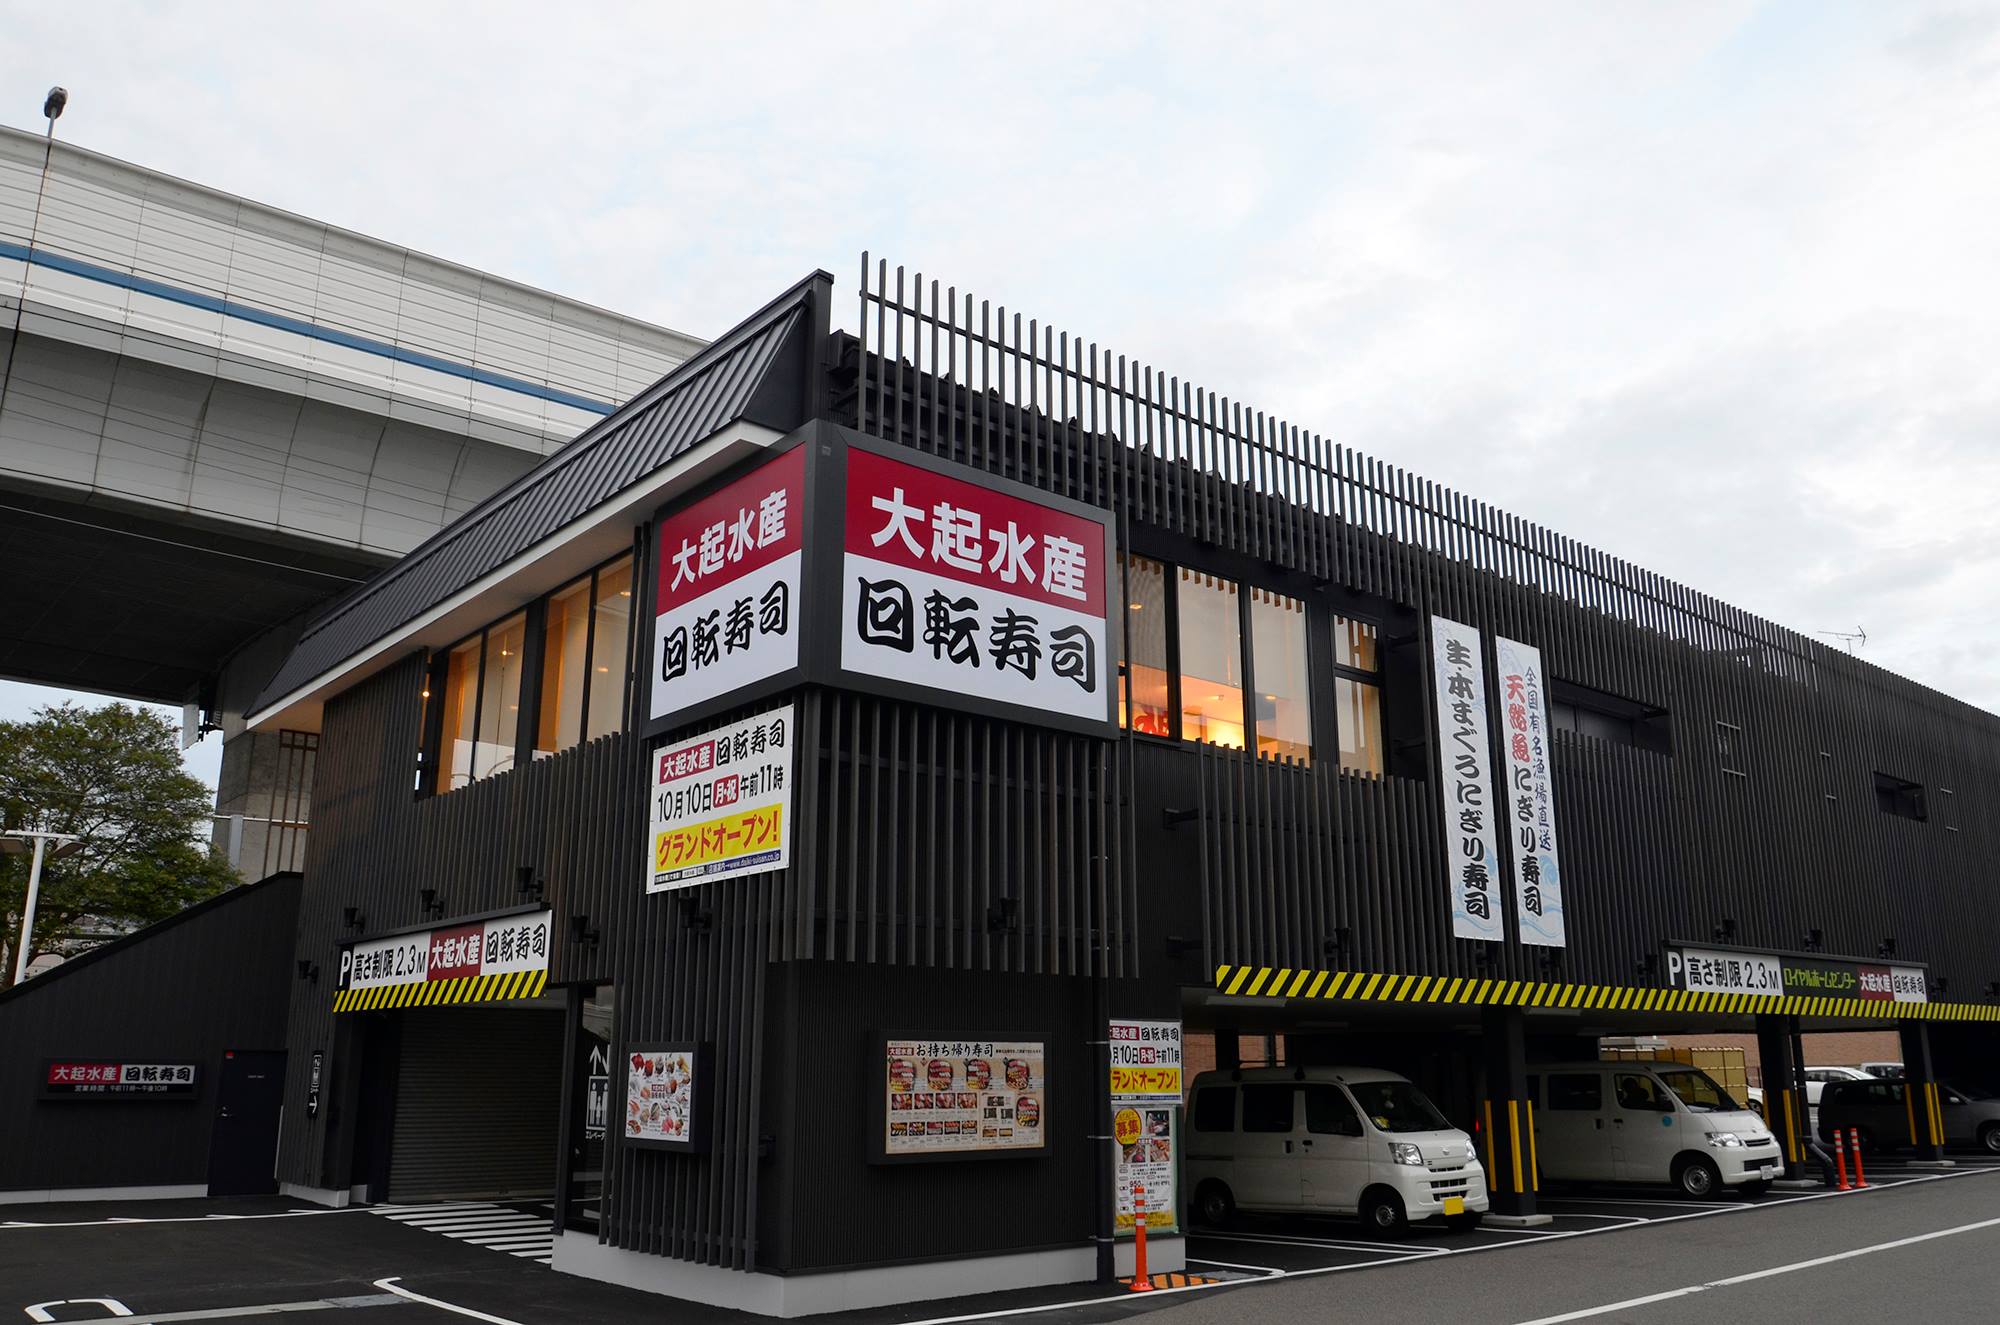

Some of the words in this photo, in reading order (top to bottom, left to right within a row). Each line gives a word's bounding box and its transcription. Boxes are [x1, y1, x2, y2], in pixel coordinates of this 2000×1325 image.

[671, 488, 787, 592] 大起水産
[871, 487, 1087, 601] 大起水産
[662, 580, 788, 682] 回転寿司
[858, 577, 1095, 693] 回転寿司
[664, 745, 711, 780] 大起水産
[716, 719, 785, 766] 回転寿司
[1525, 666, 1552, 851] 全国有名漁場直送
[658, 783, 712, 822] 10月10日
[740, 764, 783, 799] 午前11時
[1505, 675, 1542, 916] 天然魚にぎり寿司
[659, 811, 778, 866] グランドオープン!
[339, 951, 351, 986] P
[430, 934, 481, 970] 大起水産
[485, 922, 546, 964] 回転寿司
[1667, 951, 1682, 986] P
[1784, 967, 1856, 989] ロイヤルホームセンター
[1860, 972, 1892, 992] 大起水産
[916, 1043, 993, 1058] お持ち帰り寿司
[1110, 1027, 1137, 1039] 起水産
[1142, 1027, 1179, 1041] 回転寿司
[54, 1066, 117, 1081] 大起水産
[125, 1066, 191, 1082] 回転寿司
[1111, 1070, 1177, 1090] ランドオープン!
